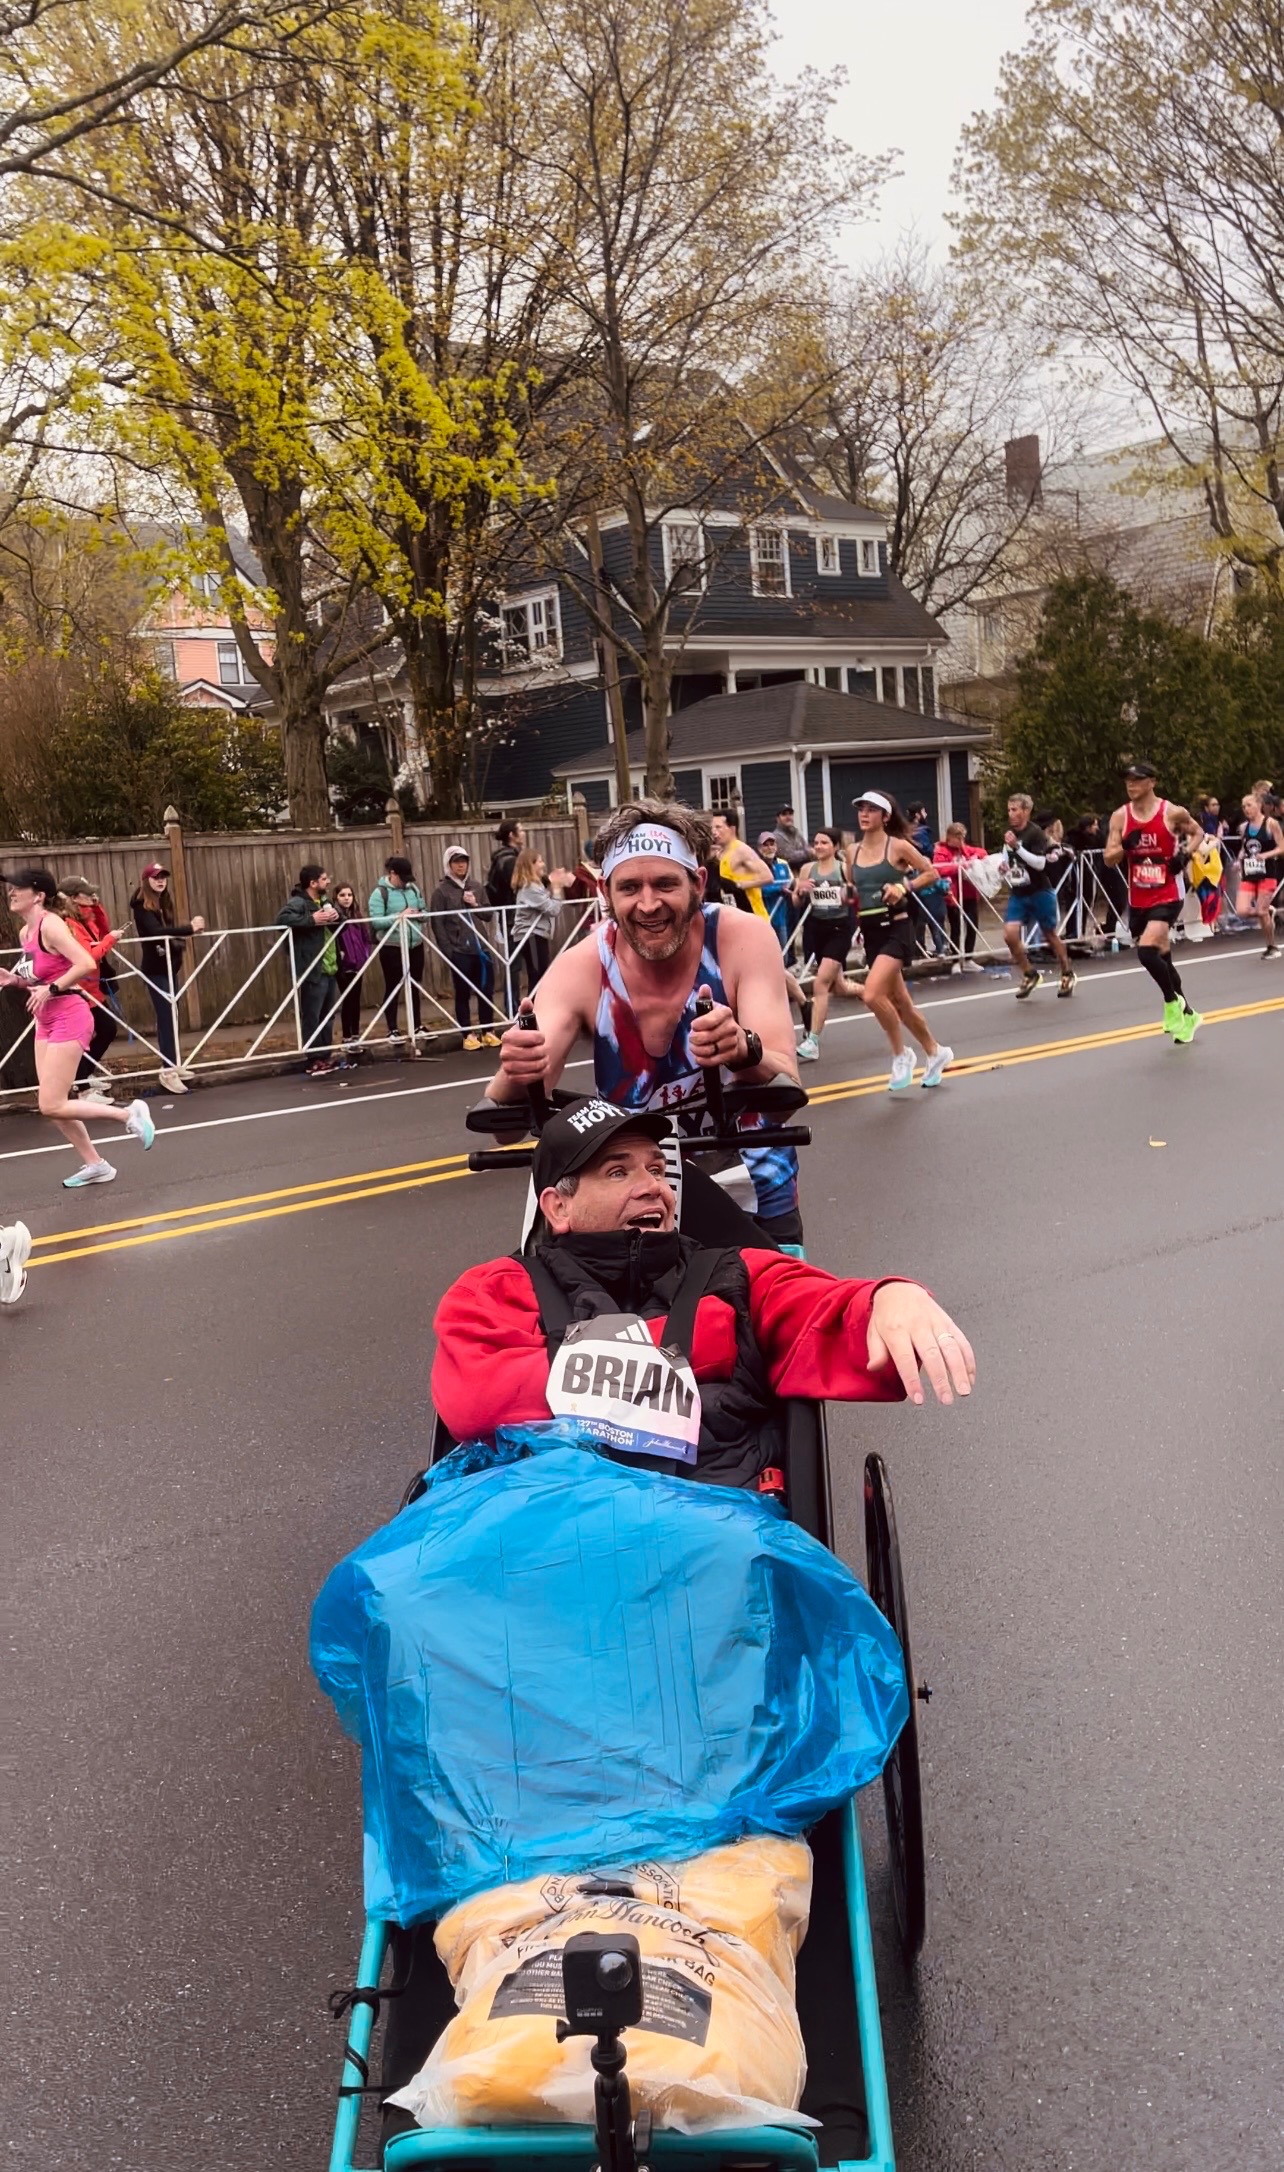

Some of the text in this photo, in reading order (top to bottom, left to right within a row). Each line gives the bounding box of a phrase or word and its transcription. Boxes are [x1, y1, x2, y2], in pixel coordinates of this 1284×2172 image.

[628, 838, 672, 854] HOYT
[567, 1106, 590, 1123] TEAM
[572, 1103, 626, 1133] HOYT
[561, 1353, 694, 1418] BRIAN
[598, 1422, 634, 1439] BOSTON
[684, 1959, 715, 1986] BAG
